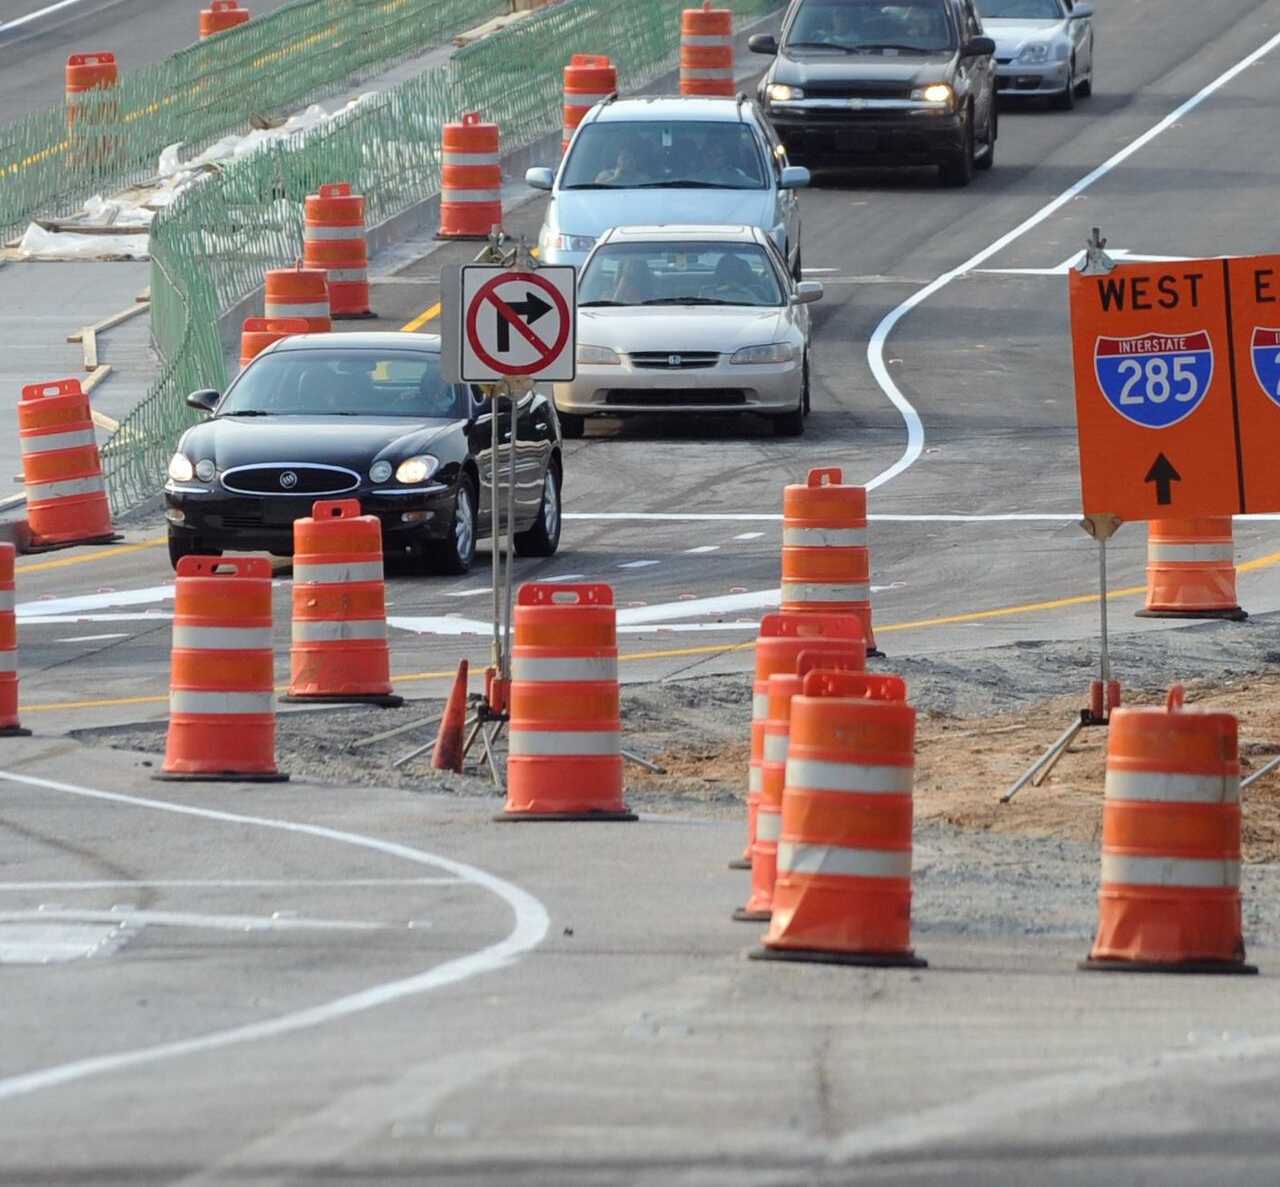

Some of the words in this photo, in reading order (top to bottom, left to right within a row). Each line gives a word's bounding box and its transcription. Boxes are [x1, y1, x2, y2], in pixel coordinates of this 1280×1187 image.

[1097, 274, 1204, 312] WEST
[1118, 337, 1188, 353] INTERSTATE
[1116, 355, 1199, 406] 285
